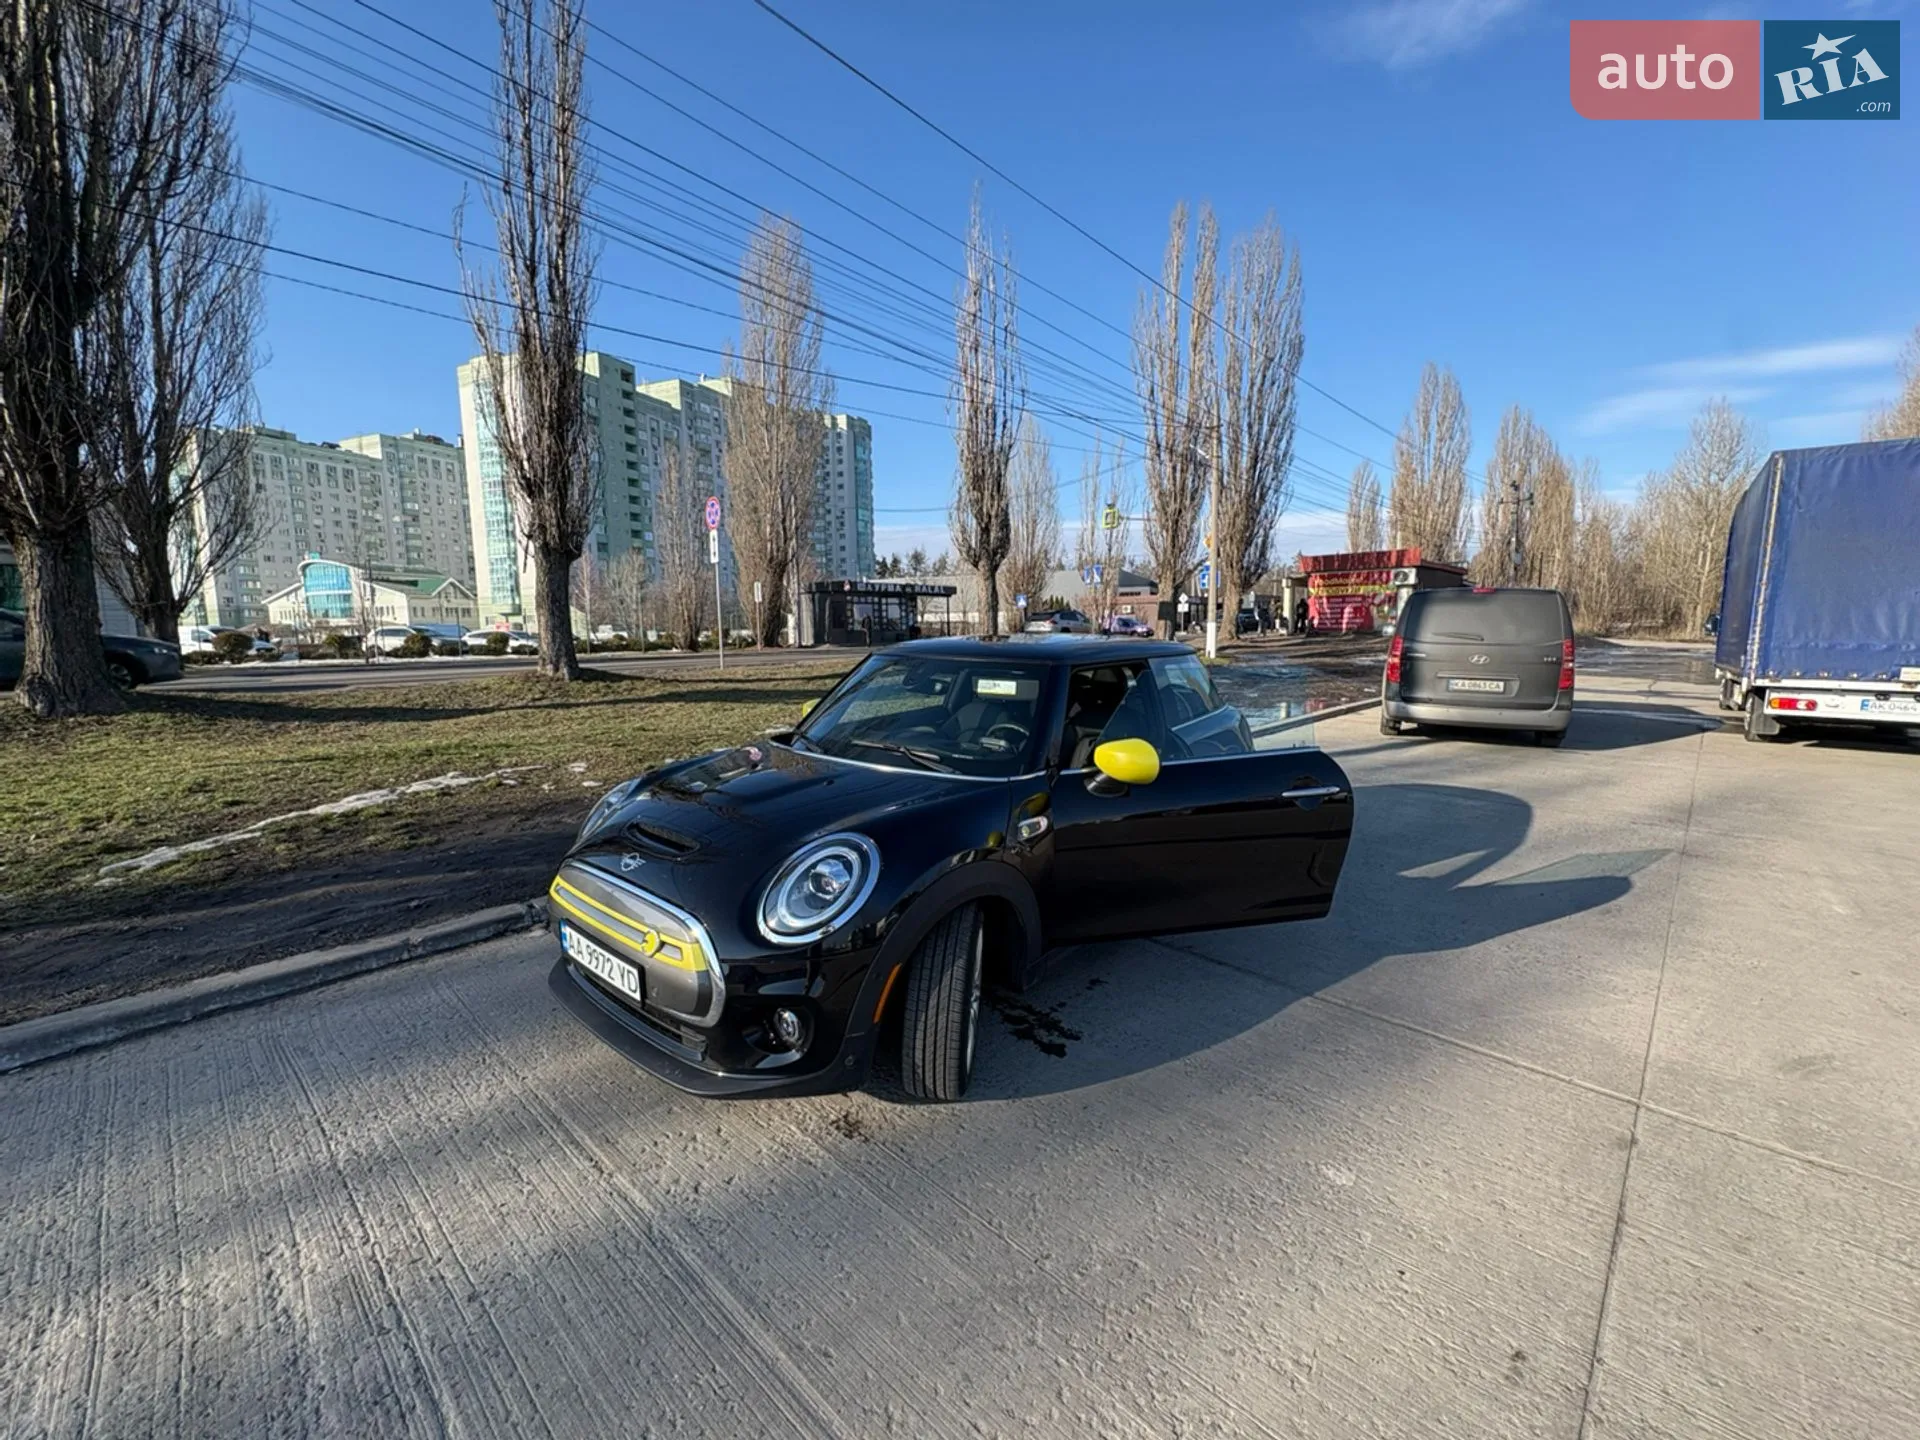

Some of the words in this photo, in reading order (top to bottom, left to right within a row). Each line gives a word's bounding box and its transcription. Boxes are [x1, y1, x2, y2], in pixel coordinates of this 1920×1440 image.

[1488, 682, 1501, 690] CA
[568, 931, 585, 960] AA
[585, 944, 616, 981] 9972
[617, 963, 638, 994] YD
